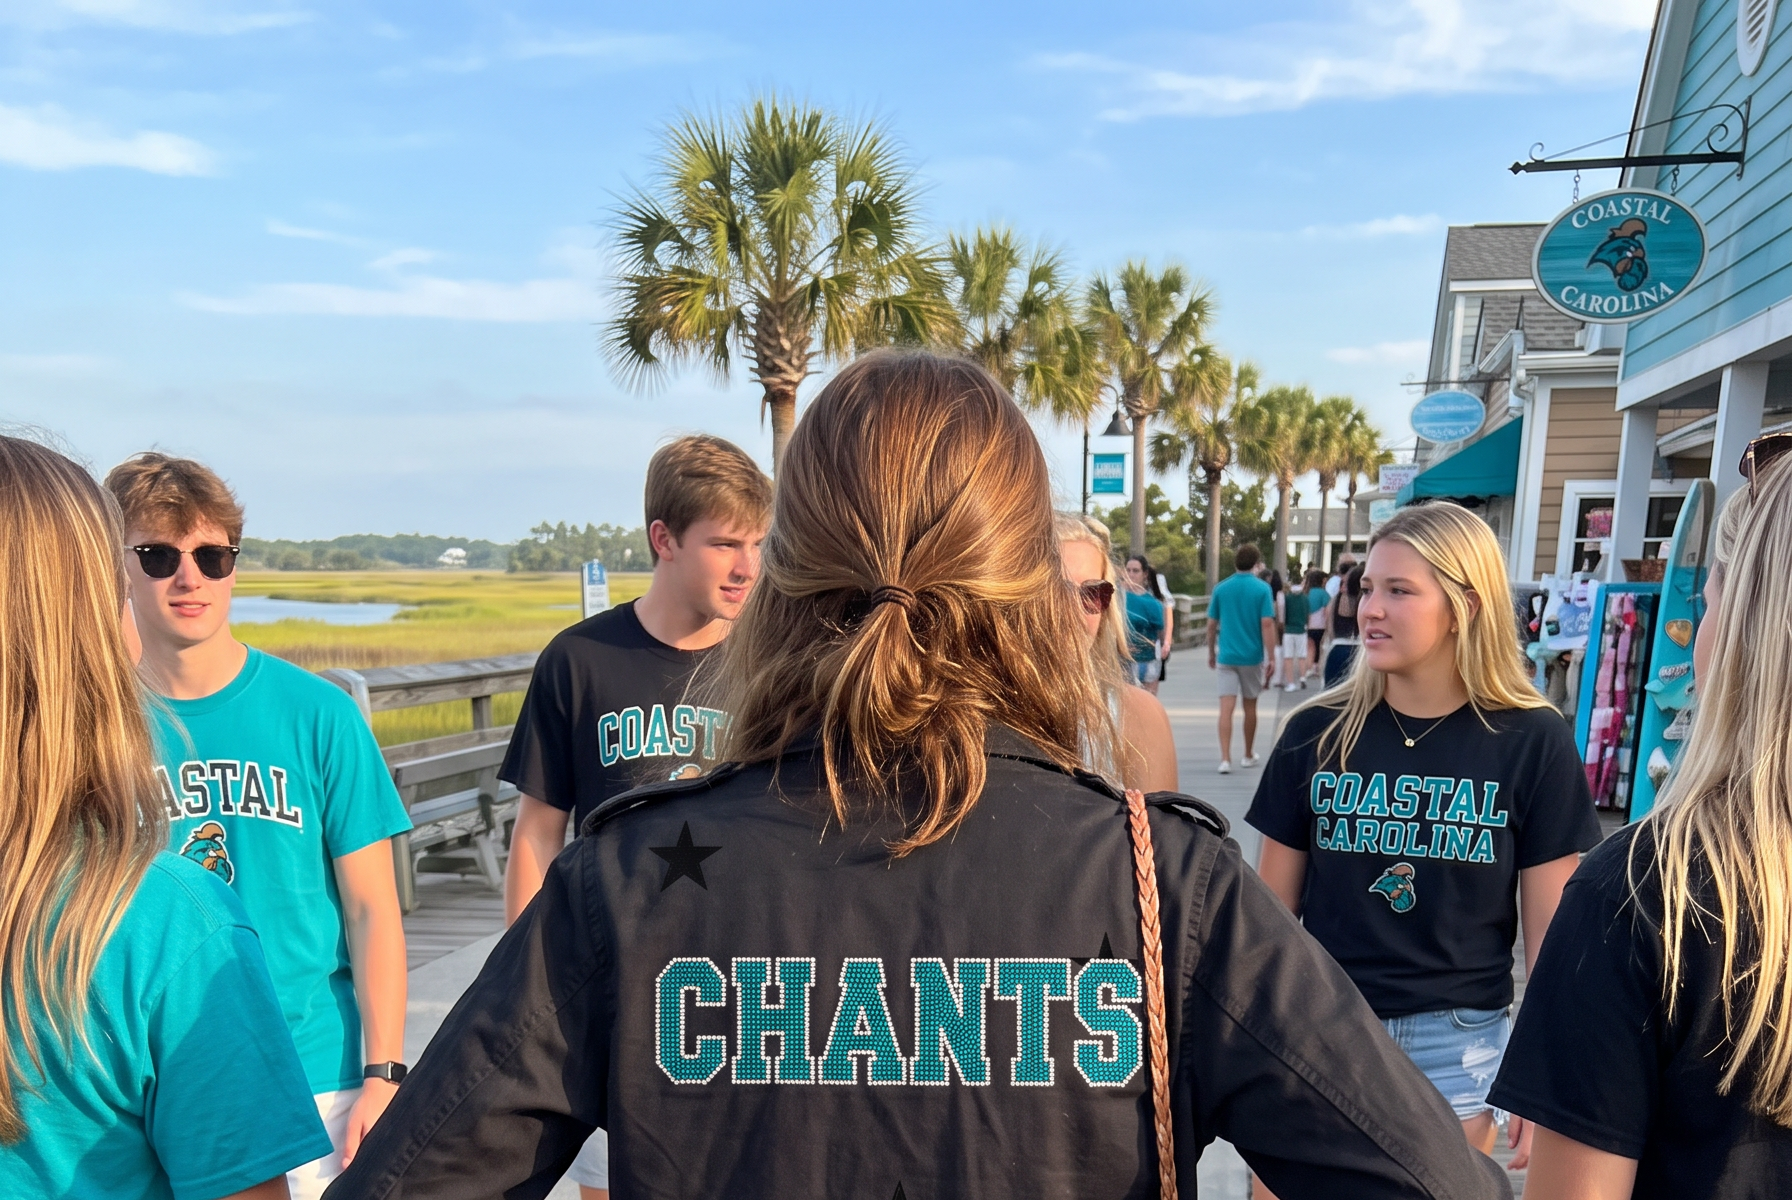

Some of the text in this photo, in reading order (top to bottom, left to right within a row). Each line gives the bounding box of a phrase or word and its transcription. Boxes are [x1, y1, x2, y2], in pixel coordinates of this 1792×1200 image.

[1571, 197, 1672, 229] COASTAL
[1560, 281, 1675, 314] CAROLINA
[598, 704, 734, 768] COAST
[138, 760, 303, 829] ASTAL
[1310, 771, 1508, 827] COASTAL
[1316, 816, 1496, 863] CAROLINA
[655, 957, 1143, 1087] CHANTS
